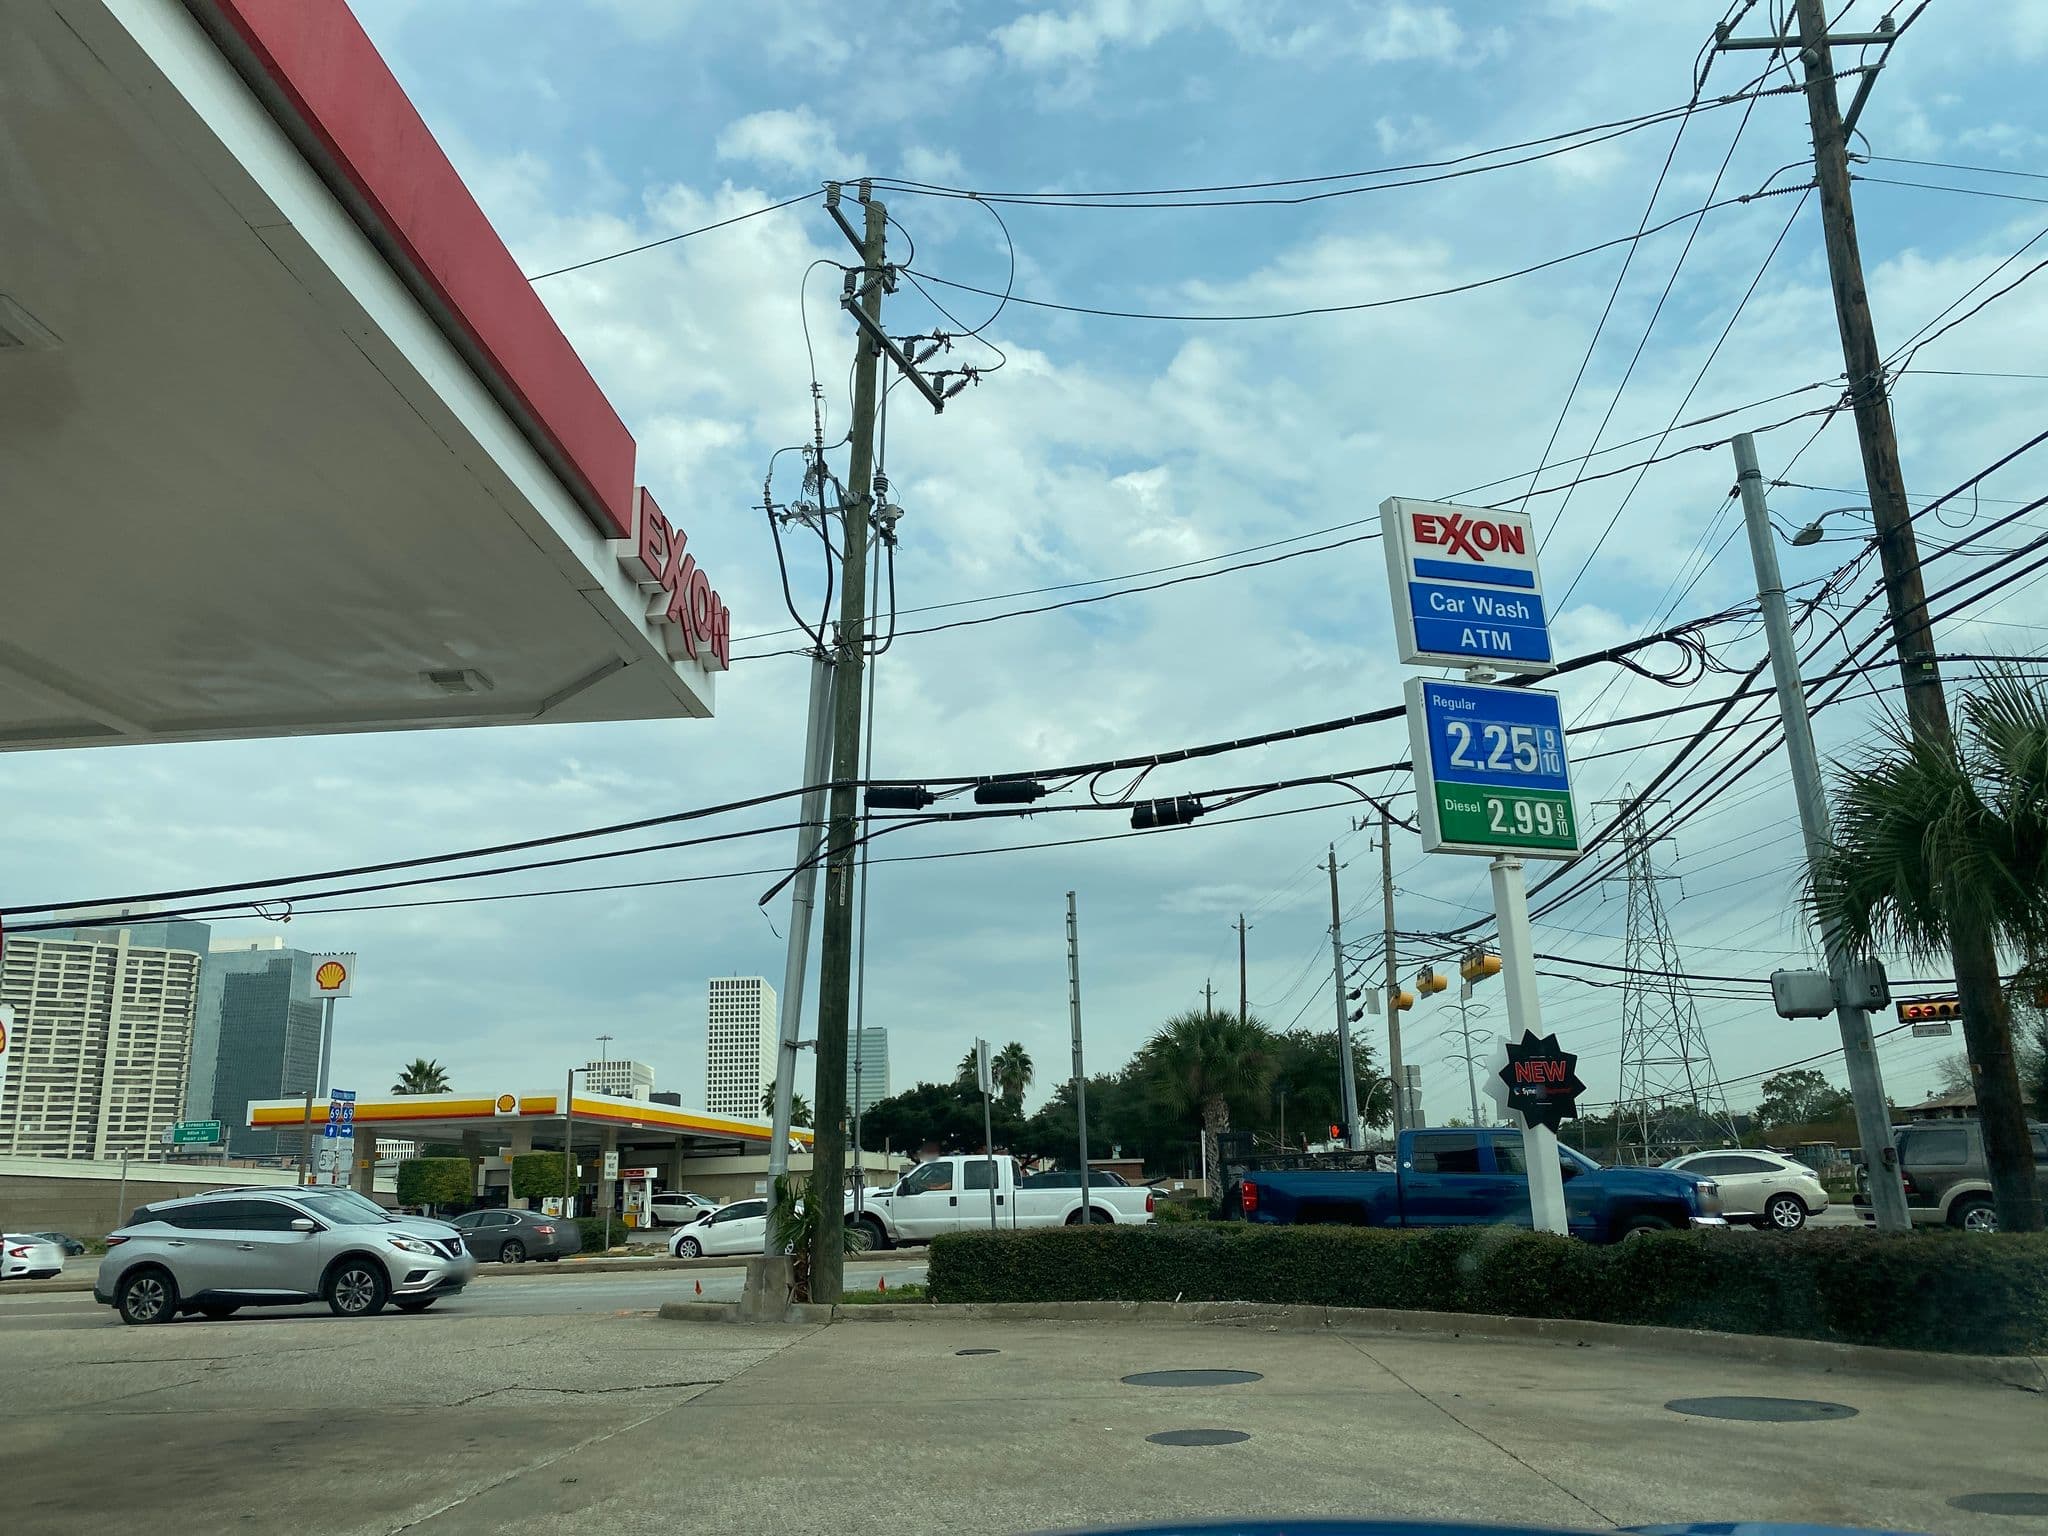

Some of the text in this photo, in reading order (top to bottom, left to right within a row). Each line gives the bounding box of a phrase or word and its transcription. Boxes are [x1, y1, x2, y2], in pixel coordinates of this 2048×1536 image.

[1411, 513, 1525, 562] EXXON
[639, 486, 730, 671] EXXON
[1429, 592, 1530, 620] Car Wash
[1460, 628, 1512, 651] ATM
[1433, 694, 1476, 712] Regular
[1447, 721, 1538, 773] 2.25
[1444, 798, 1481, 813] Diesel
[1487, 798, 1554, 836] 2.99
[1514, 1060, 1567, 1083] NEW
[329, 1108, 340, 1119] 69
[343, 1108, 354, 1119] 69
